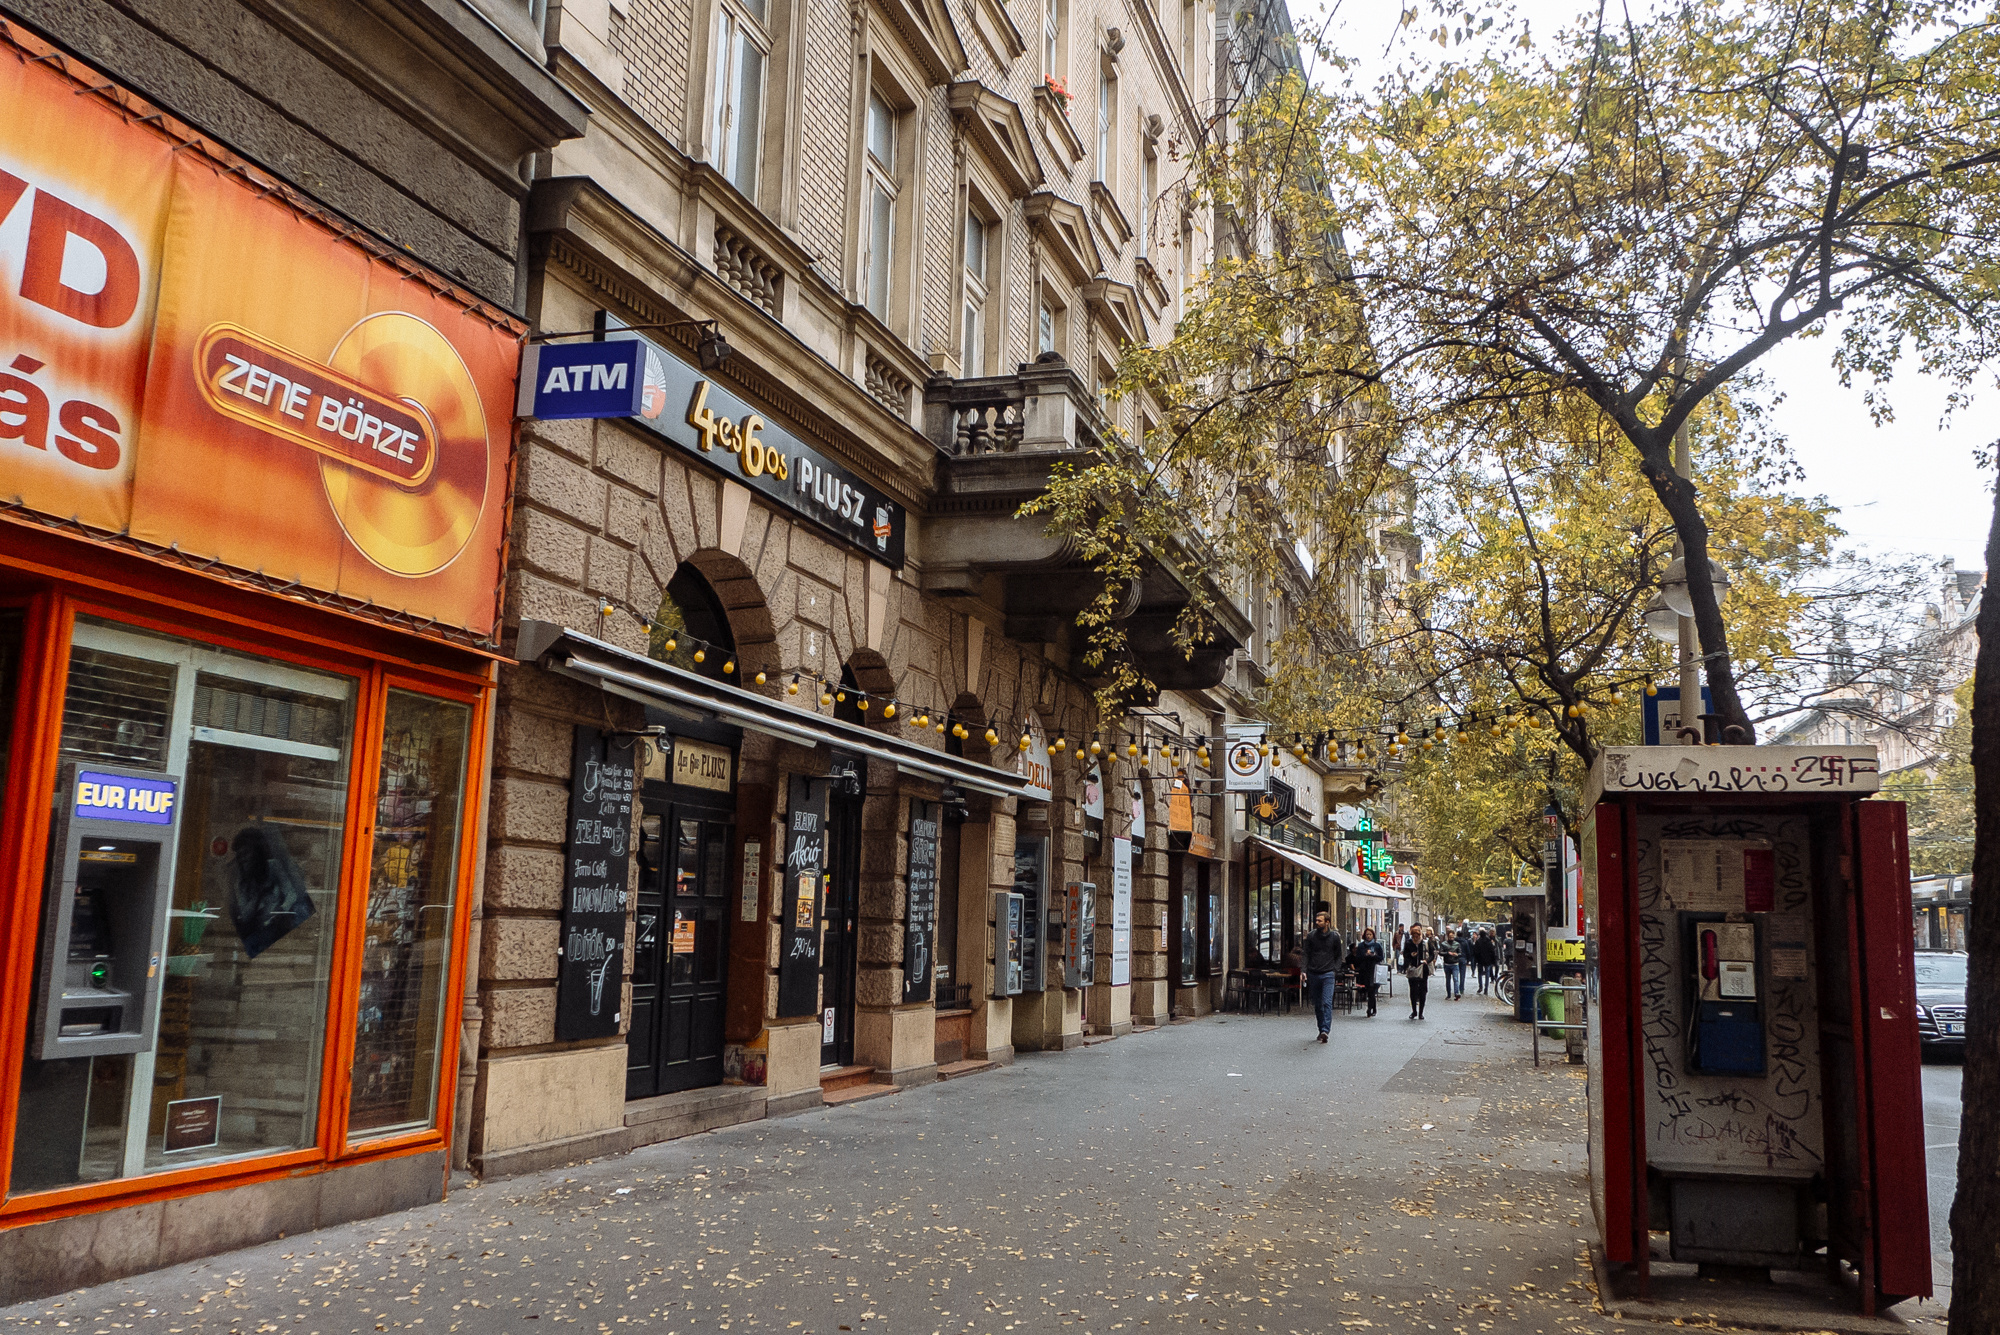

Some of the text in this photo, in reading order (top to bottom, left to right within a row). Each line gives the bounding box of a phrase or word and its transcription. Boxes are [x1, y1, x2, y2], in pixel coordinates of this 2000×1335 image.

[542, 362, 628, 394] ATM
[218, 353, 420, 465] ZENE BÖRZE
[797, 456, 865, 527] PLUSZ
[701, 753, 726, 780] PLUSZ
[76, 781, 175, 814] EUR HUF
[575, 818, 613, 844] TEA 350
[793, 810, 818, 833] HAVI
[787, 834, 822, 870] Akció
